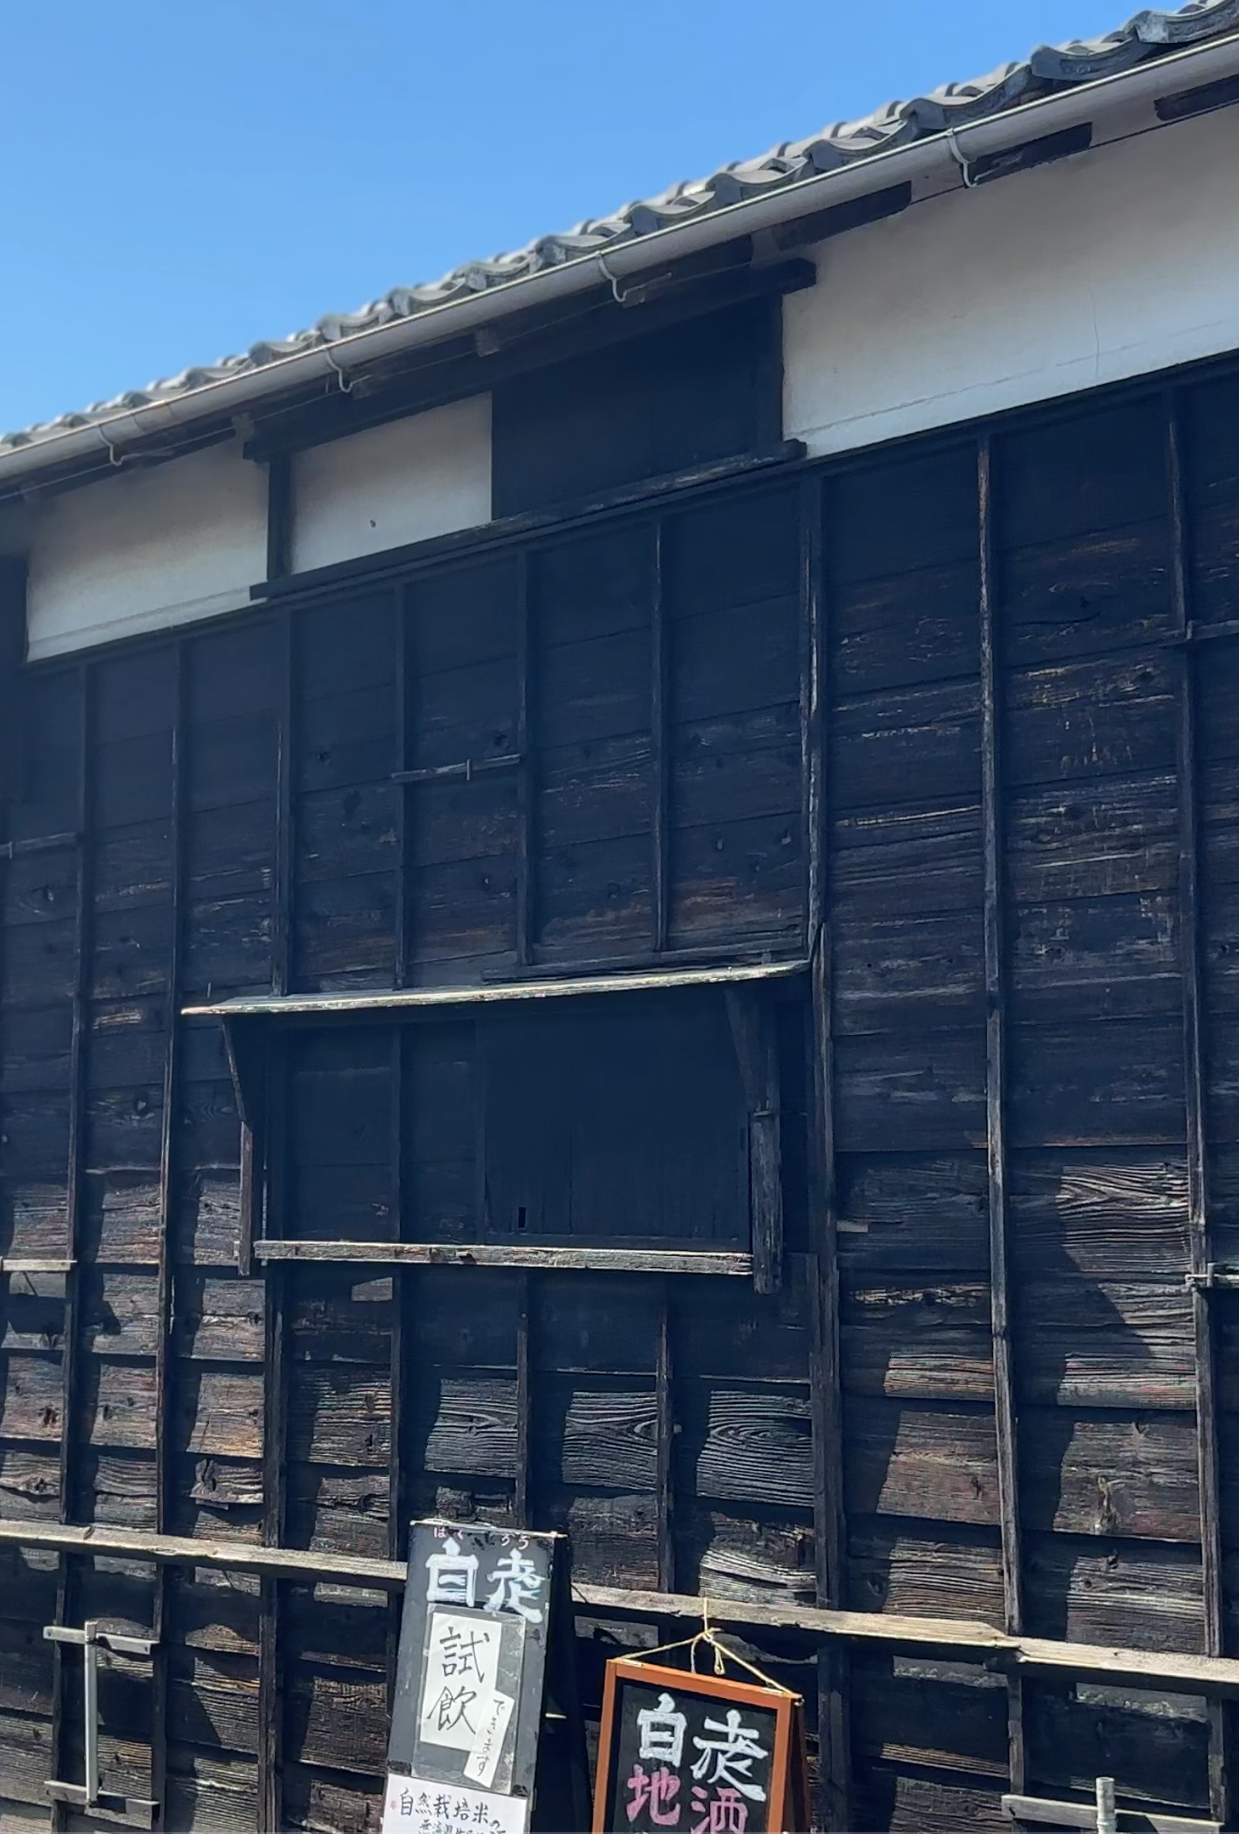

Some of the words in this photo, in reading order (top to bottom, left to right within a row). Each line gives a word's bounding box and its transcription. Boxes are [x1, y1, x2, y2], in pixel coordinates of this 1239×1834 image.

[427, 1626, 490, 1735] 試飲
[400, 1787, 501, 1830] 自然栽培米の
[626, 1763, 748, 1834] 地酒
